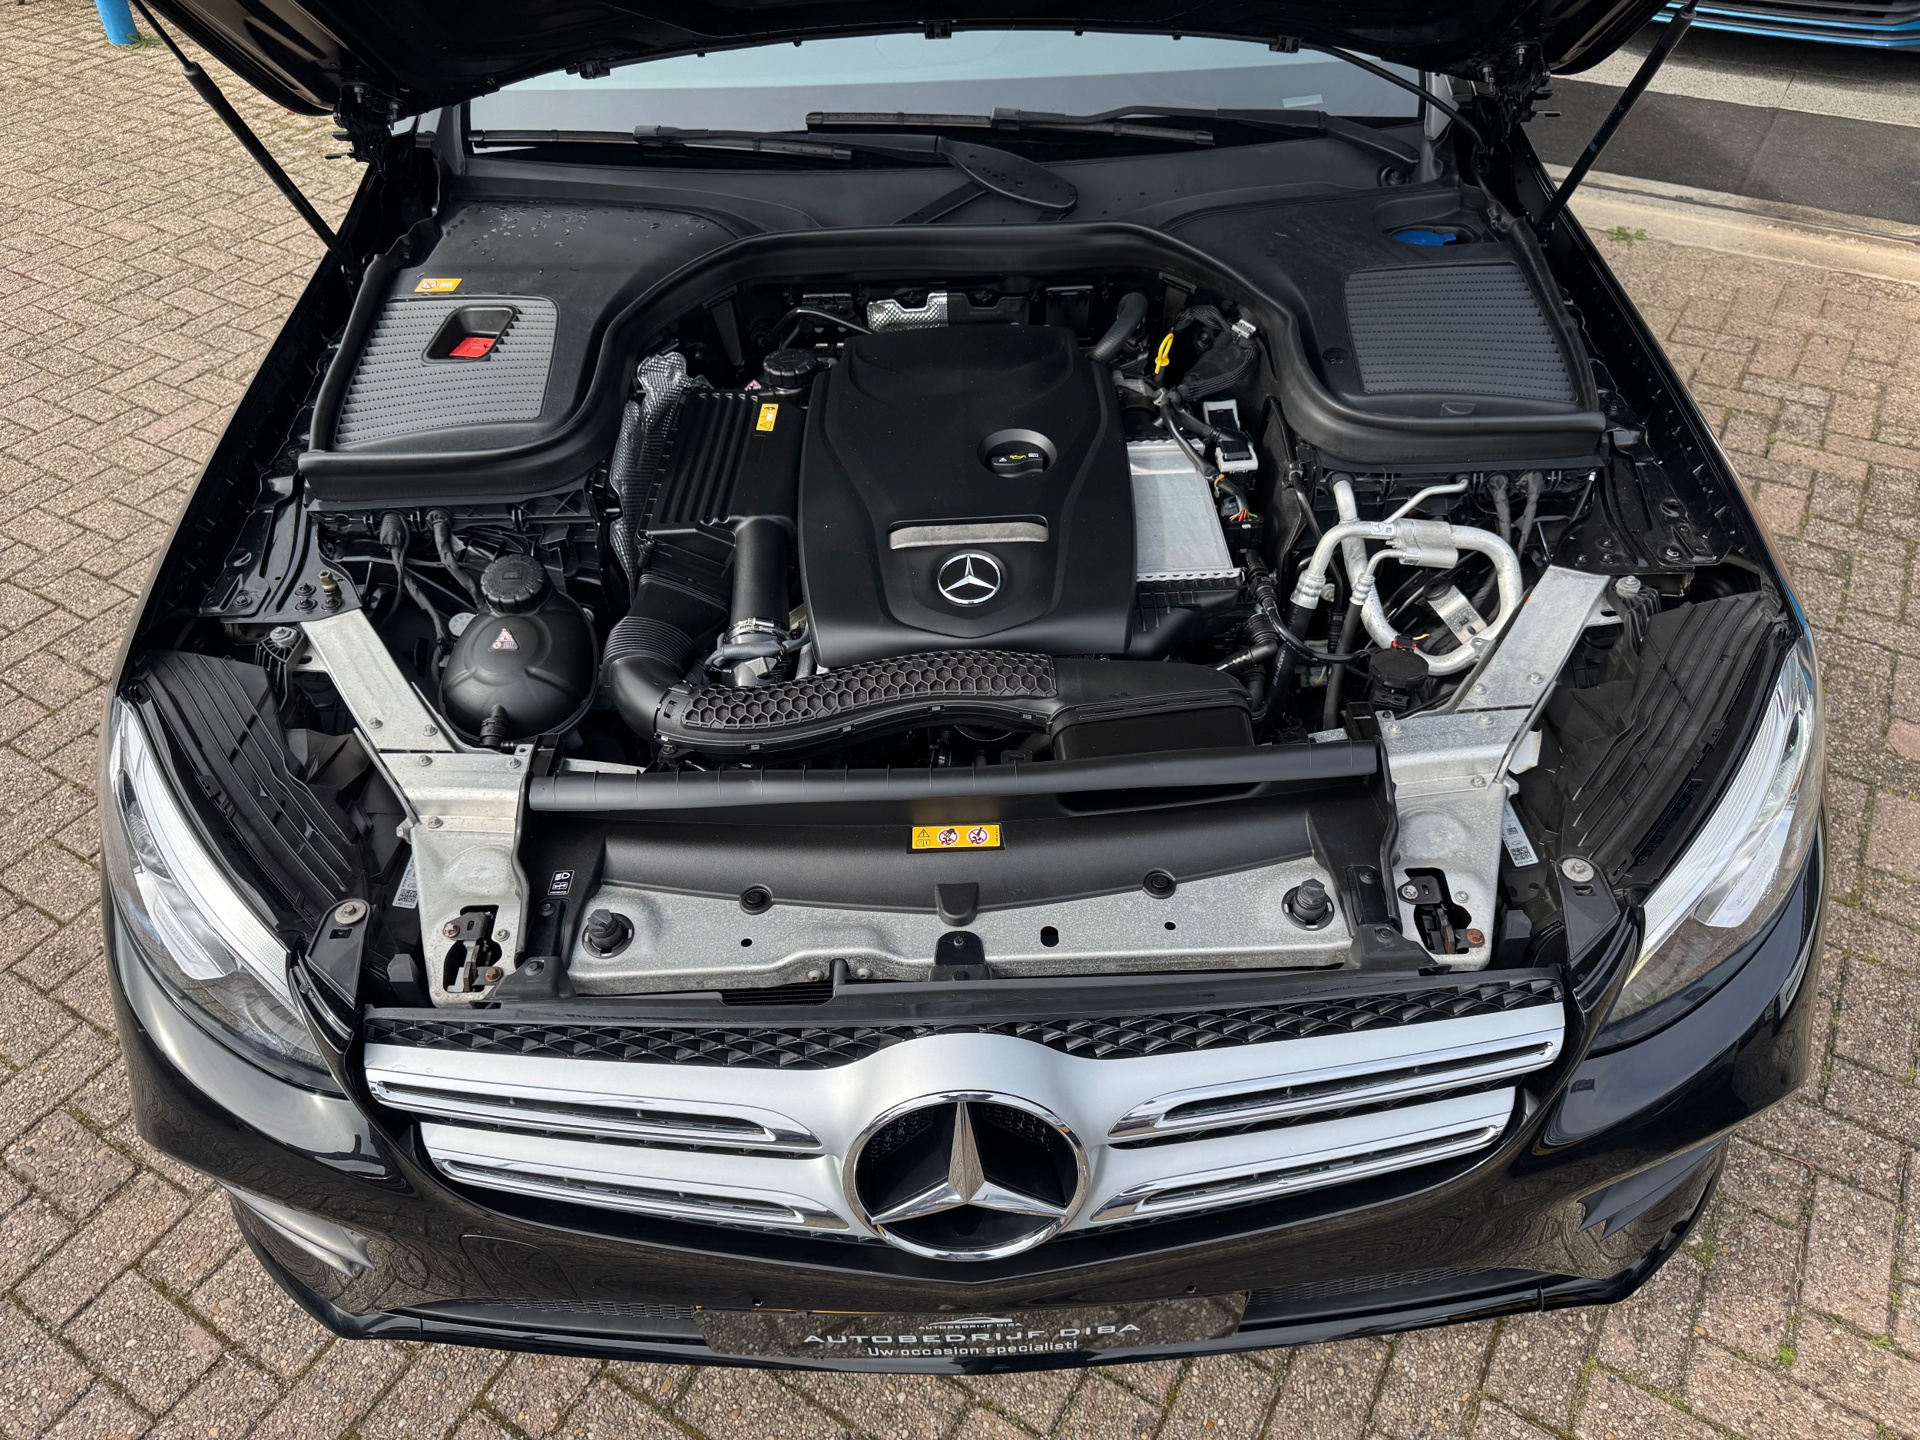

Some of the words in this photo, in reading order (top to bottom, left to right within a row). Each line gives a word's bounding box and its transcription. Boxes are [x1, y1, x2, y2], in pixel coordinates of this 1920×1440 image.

[803, 1329, 1046, 1344] AUTOBEDRIJF
[1059, 1323, 1141, 1338] DIBA
[866, 1347, 894, 1357] Uw
[900, 1346, 980, 1357] occasion
[986, 1340, 1078, 1355] specialist!
